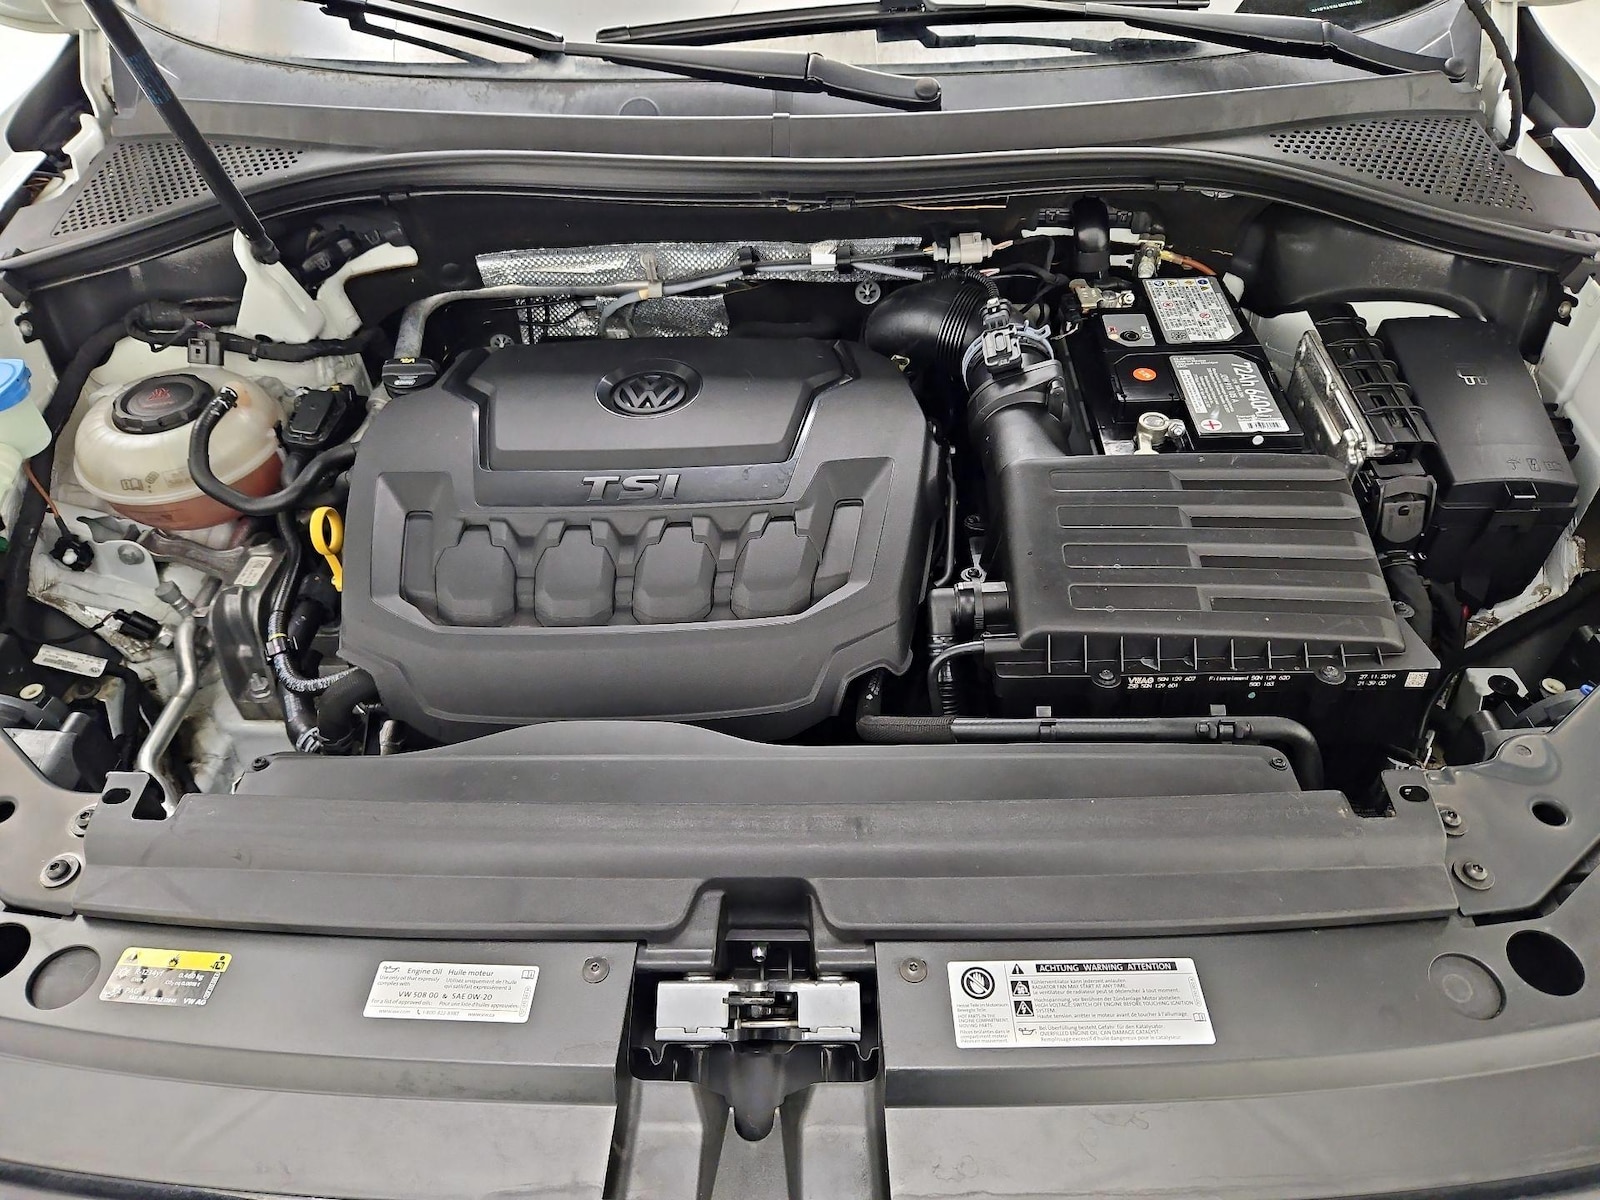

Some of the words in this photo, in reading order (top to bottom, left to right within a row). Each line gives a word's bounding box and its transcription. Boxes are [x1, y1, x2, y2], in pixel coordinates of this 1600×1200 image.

[1231, 361, 1259, 387] 72Ah
[582, 473, 681, 501] TSI
[407, 967, 431, 976] Engine
[1039, 964, 1080, 972] ACHTUNG
[1083, 963, 1124, 972] WARNING
[1127, 962, 1172, 971] ATTENTION
[448, 968, 466, 976] Huile
[451, 992, 465, 1000] SAE
